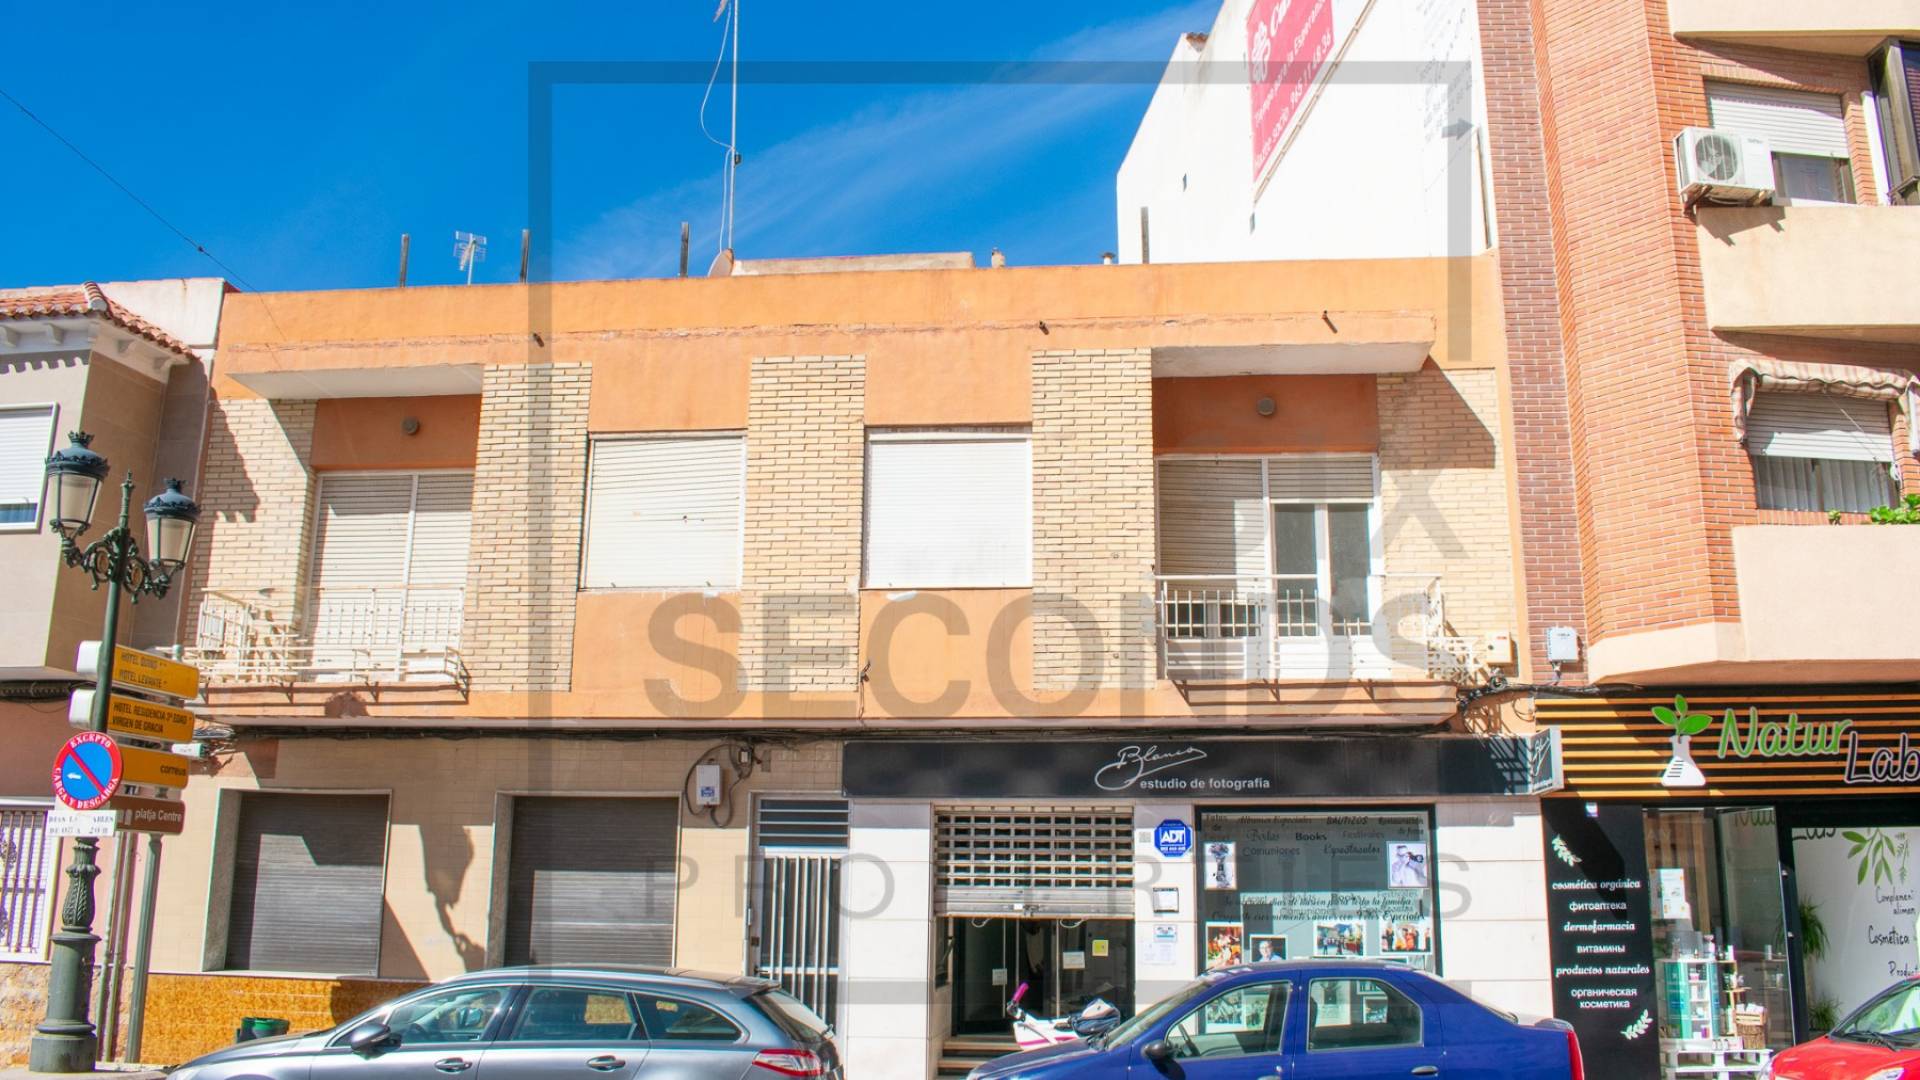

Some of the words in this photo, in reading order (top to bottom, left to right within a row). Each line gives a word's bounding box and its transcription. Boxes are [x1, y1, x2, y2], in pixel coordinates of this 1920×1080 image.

[112, 702, 132, 714] HOTEL
[134, 719, 142, 729] DE
[1718, 706, 1853, 759] Natur
[69, 733, 112, 749] EXCEPTO
[53, 767, 69, 801] CARGA
[77, 778, 119, 809] DESCARGA
[1140, 777, 1187, 789] estudio
[1190, 777, 1206, 789] de
[157, 809, 183, 822] Centre
[1161, 829, 1185, 843] ADT
[1295, 832, 1327, 841] Books
[1242, 846, 1301, 857] Comuniones
[1552, 879, 1598, 890] cosmética
[1600, 878, 1642, 891] orgánica
[1569, 901, 1627, 912] фитоаптека
[1564, 920, 1636, 933] dermofarmacia
[1576, 945, 1626, 954] витамины
[1555, 964, 1603, 978] productos
[1605, 963, 1650, 974] naturales
[1571, 988, 1638, 999] органическая
[1580, 1000, 1631, 1009] косметика
